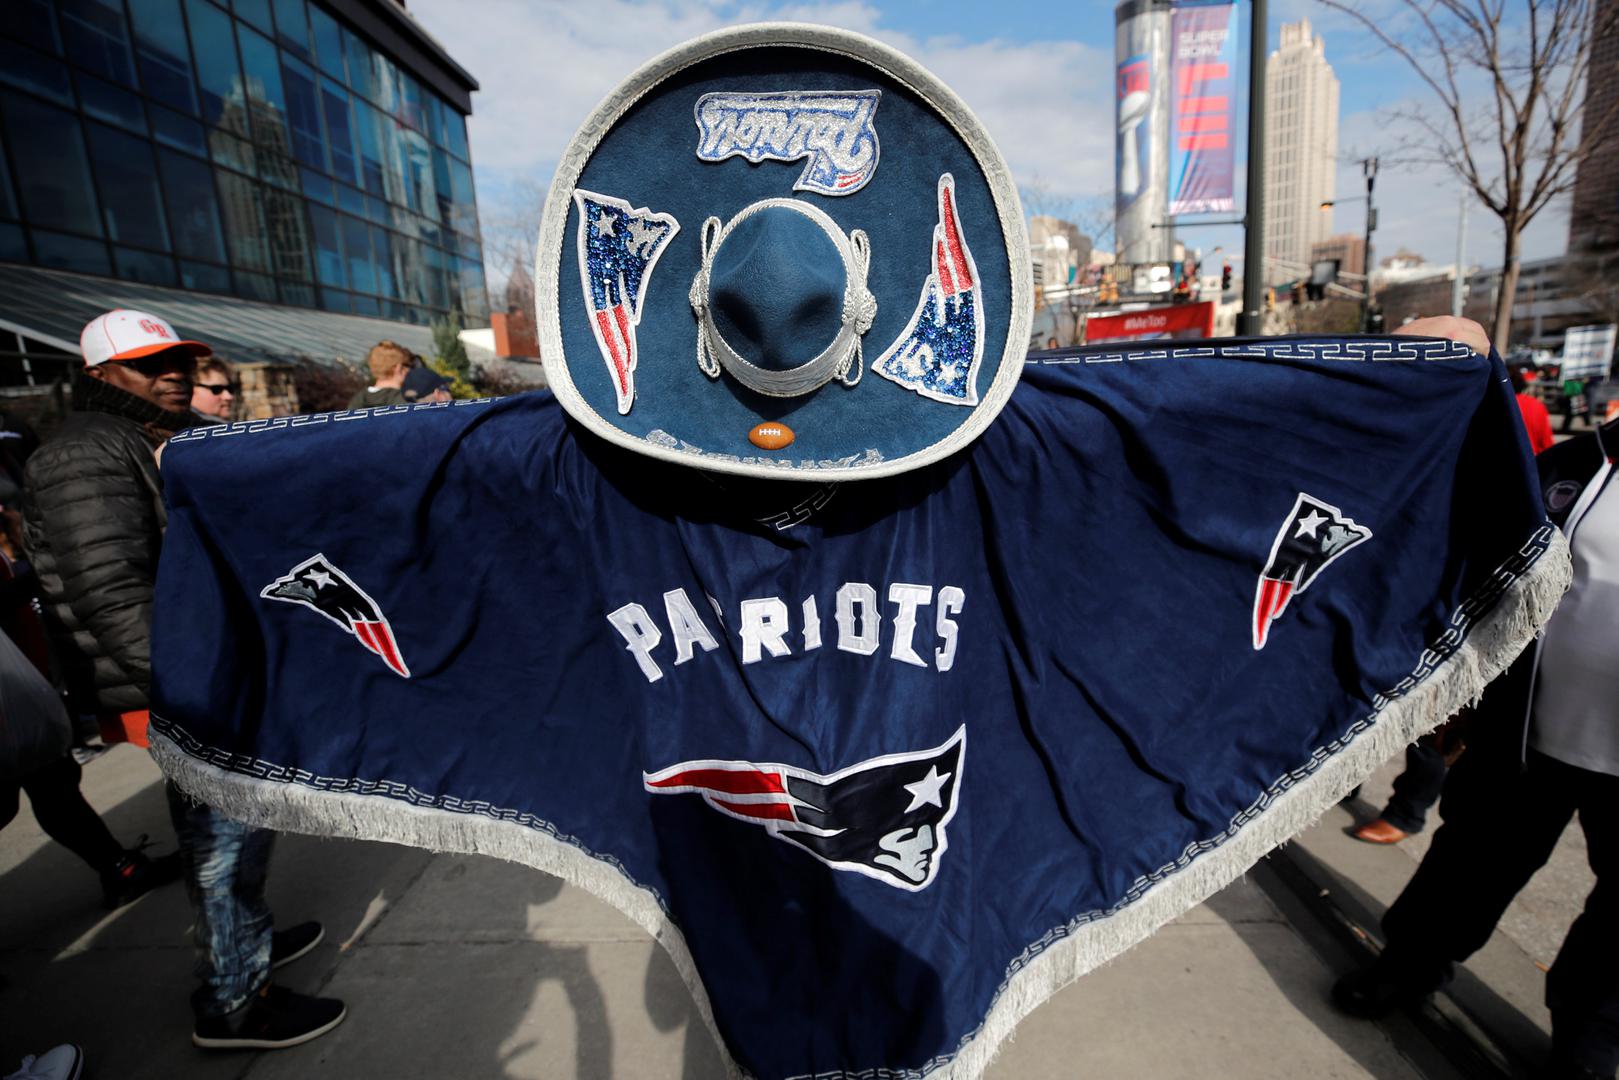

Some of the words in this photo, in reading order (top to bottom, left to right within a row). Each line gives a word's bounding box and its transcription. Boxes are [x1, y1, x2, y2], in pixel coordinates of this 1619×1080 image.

[1179, 31, 1229, 45] SUPER
[1178, 47, 1220, 59] BOWL
[1124, 315, 1167, 331] #MeToo
[606, 582, 966, 683] PARIOTS
